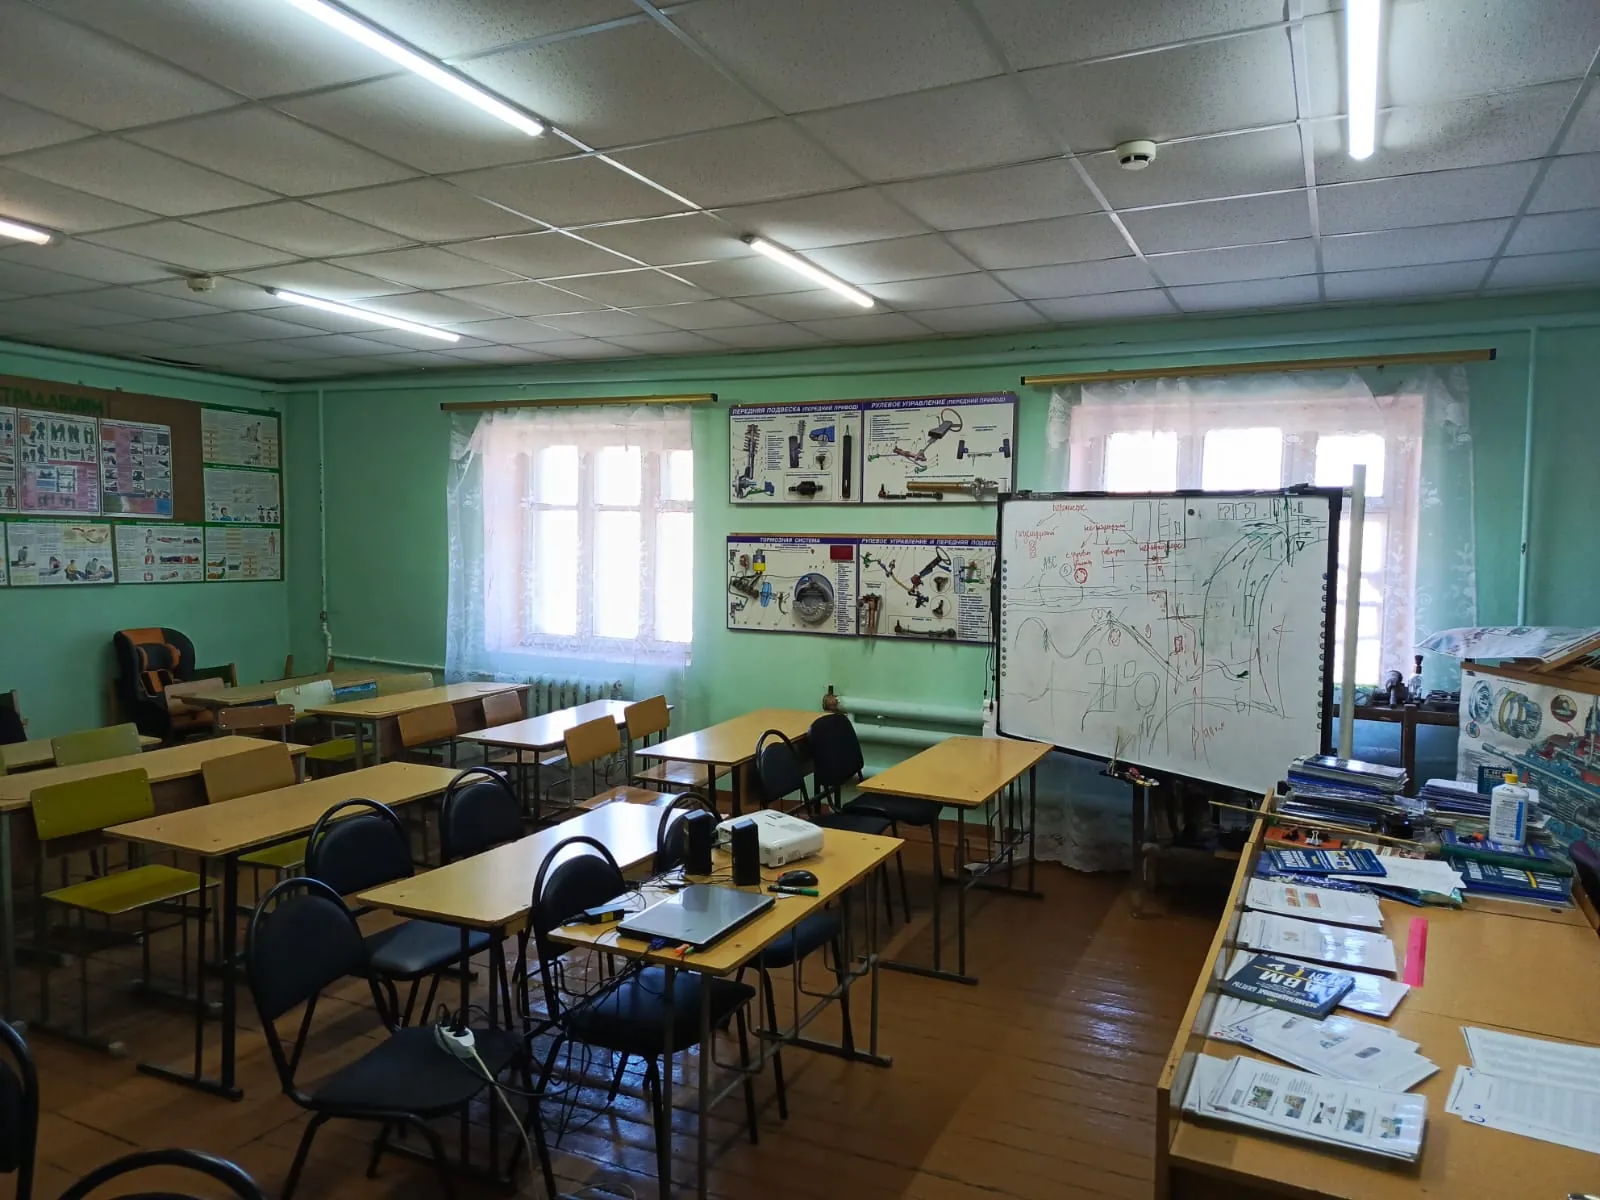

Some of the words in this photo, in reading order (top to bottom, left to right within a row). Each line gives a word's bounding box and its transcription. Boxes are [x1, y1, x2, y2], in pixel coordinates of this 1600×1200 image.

[871, 401, 901, 409] РУЛЕВОЕ
[902, 399, 946, 407] УПРАВЛЕНИЕ
[732, 407, 766, 415] ПЕРЕДНЯЯ
[766, 406, 801, 414] ПОДВЕСКА
